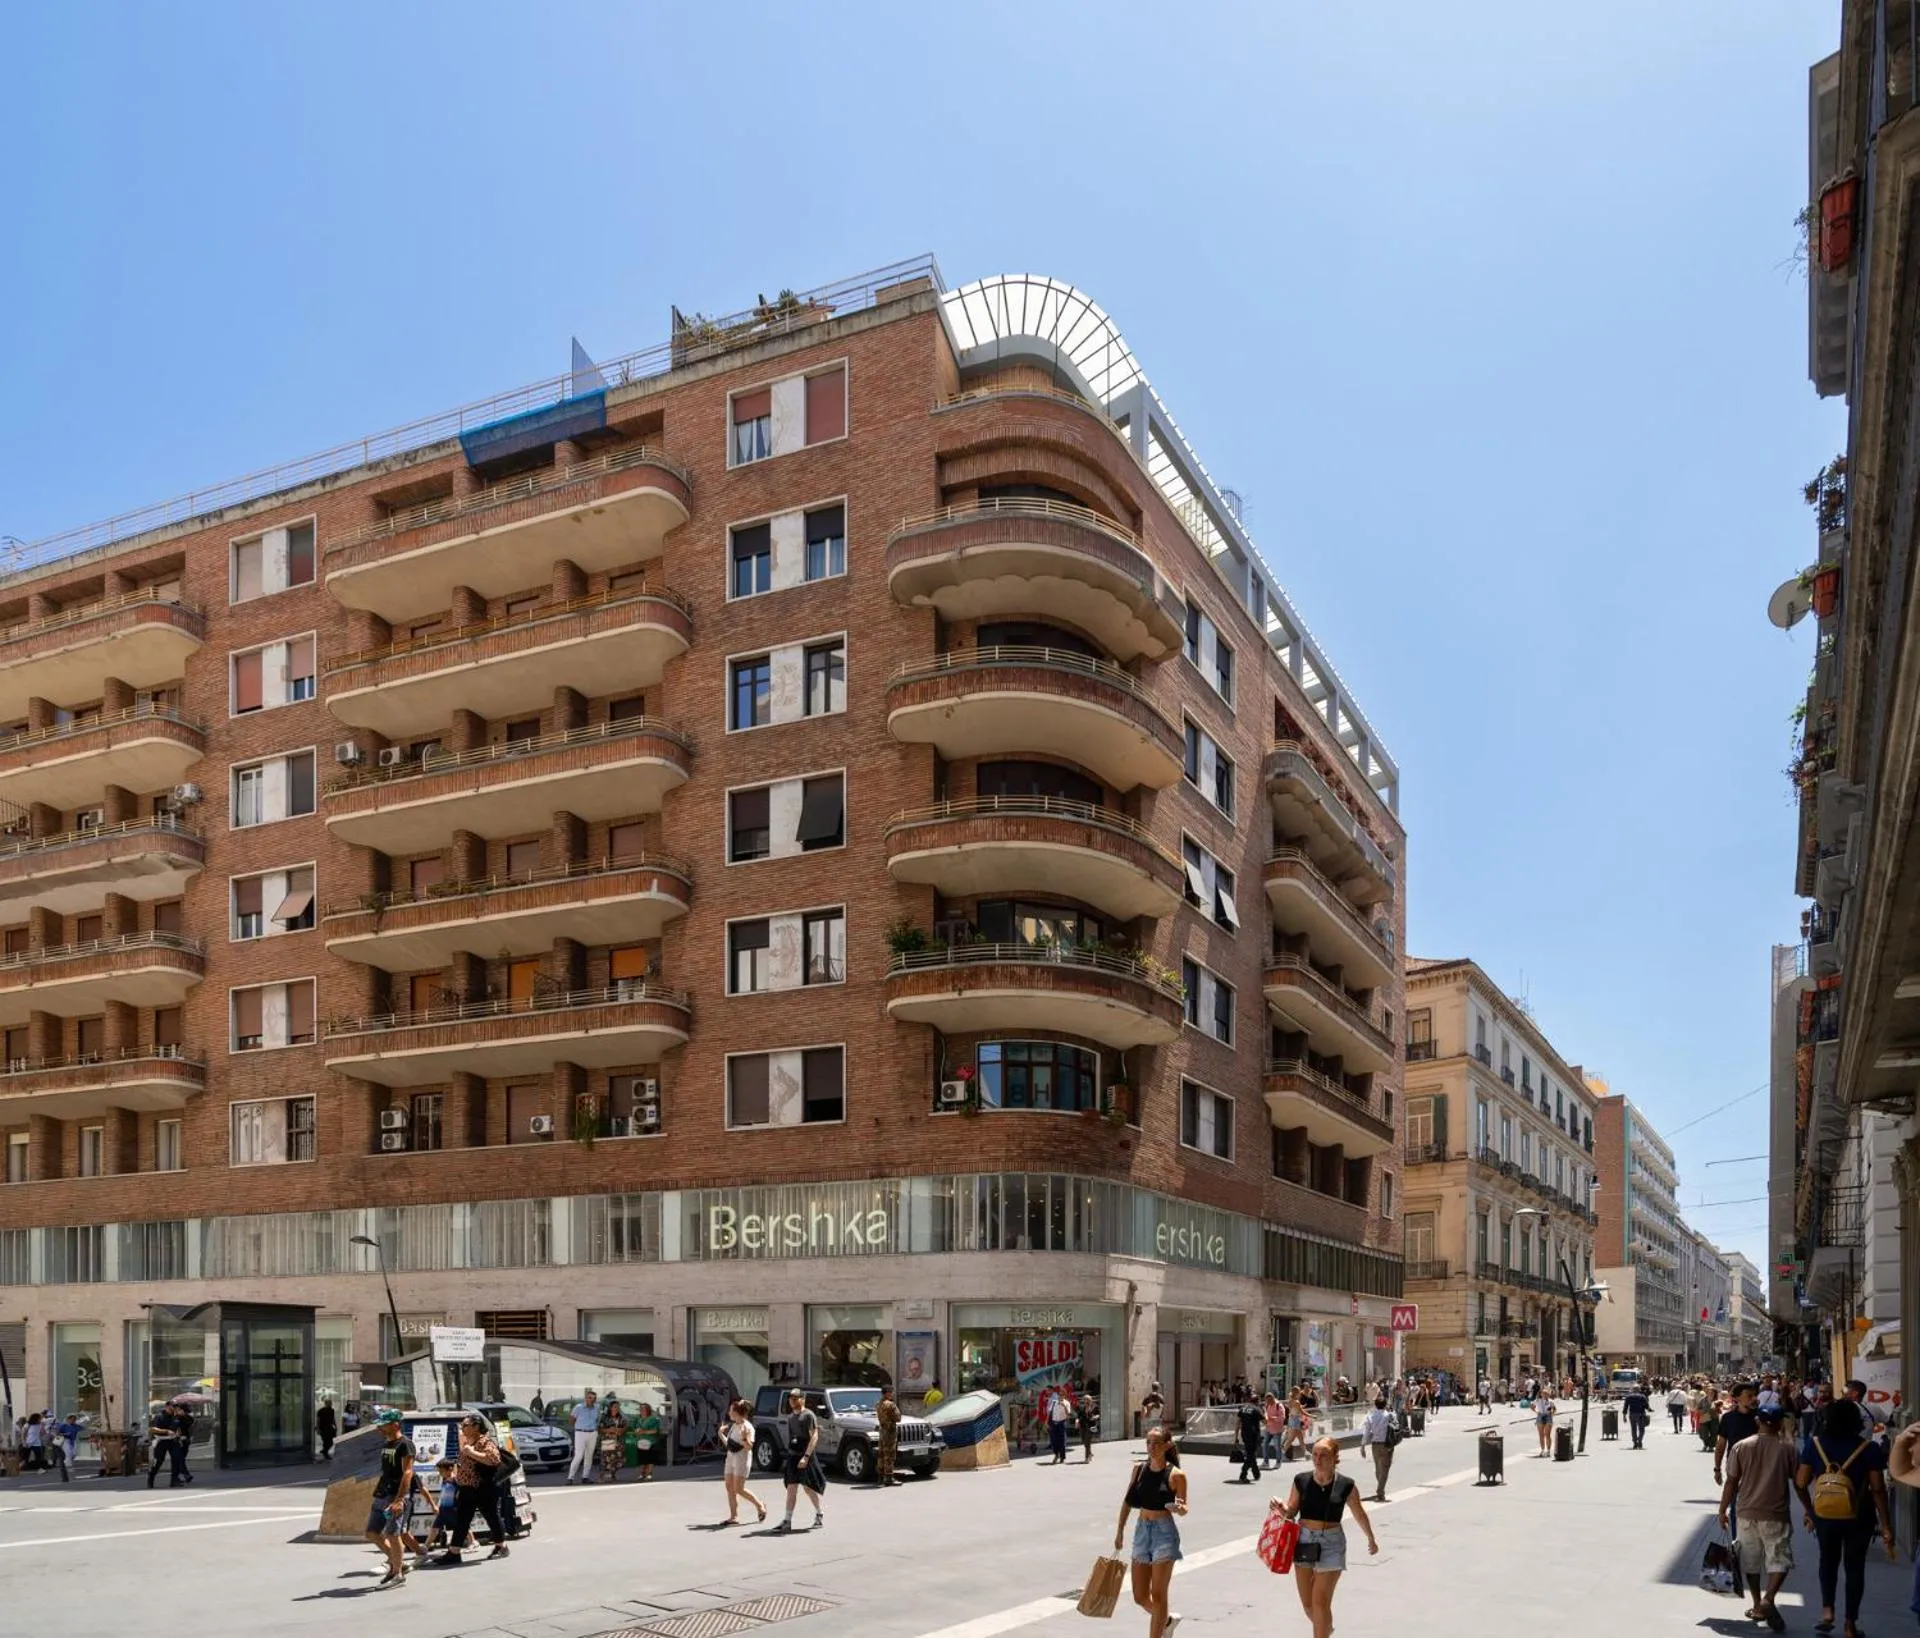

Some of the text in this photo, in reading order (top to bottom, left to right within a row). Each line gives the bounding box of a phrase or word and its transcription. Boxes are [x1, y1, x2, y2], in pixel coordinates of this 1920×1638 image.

[709, 1200, 888, 1250] Bershka
[1156, 1219, 1225, 1264] ershka
[1393, 1310, 1414, 1327] M
[1017, 1340, 1078, 1373] SALDI
